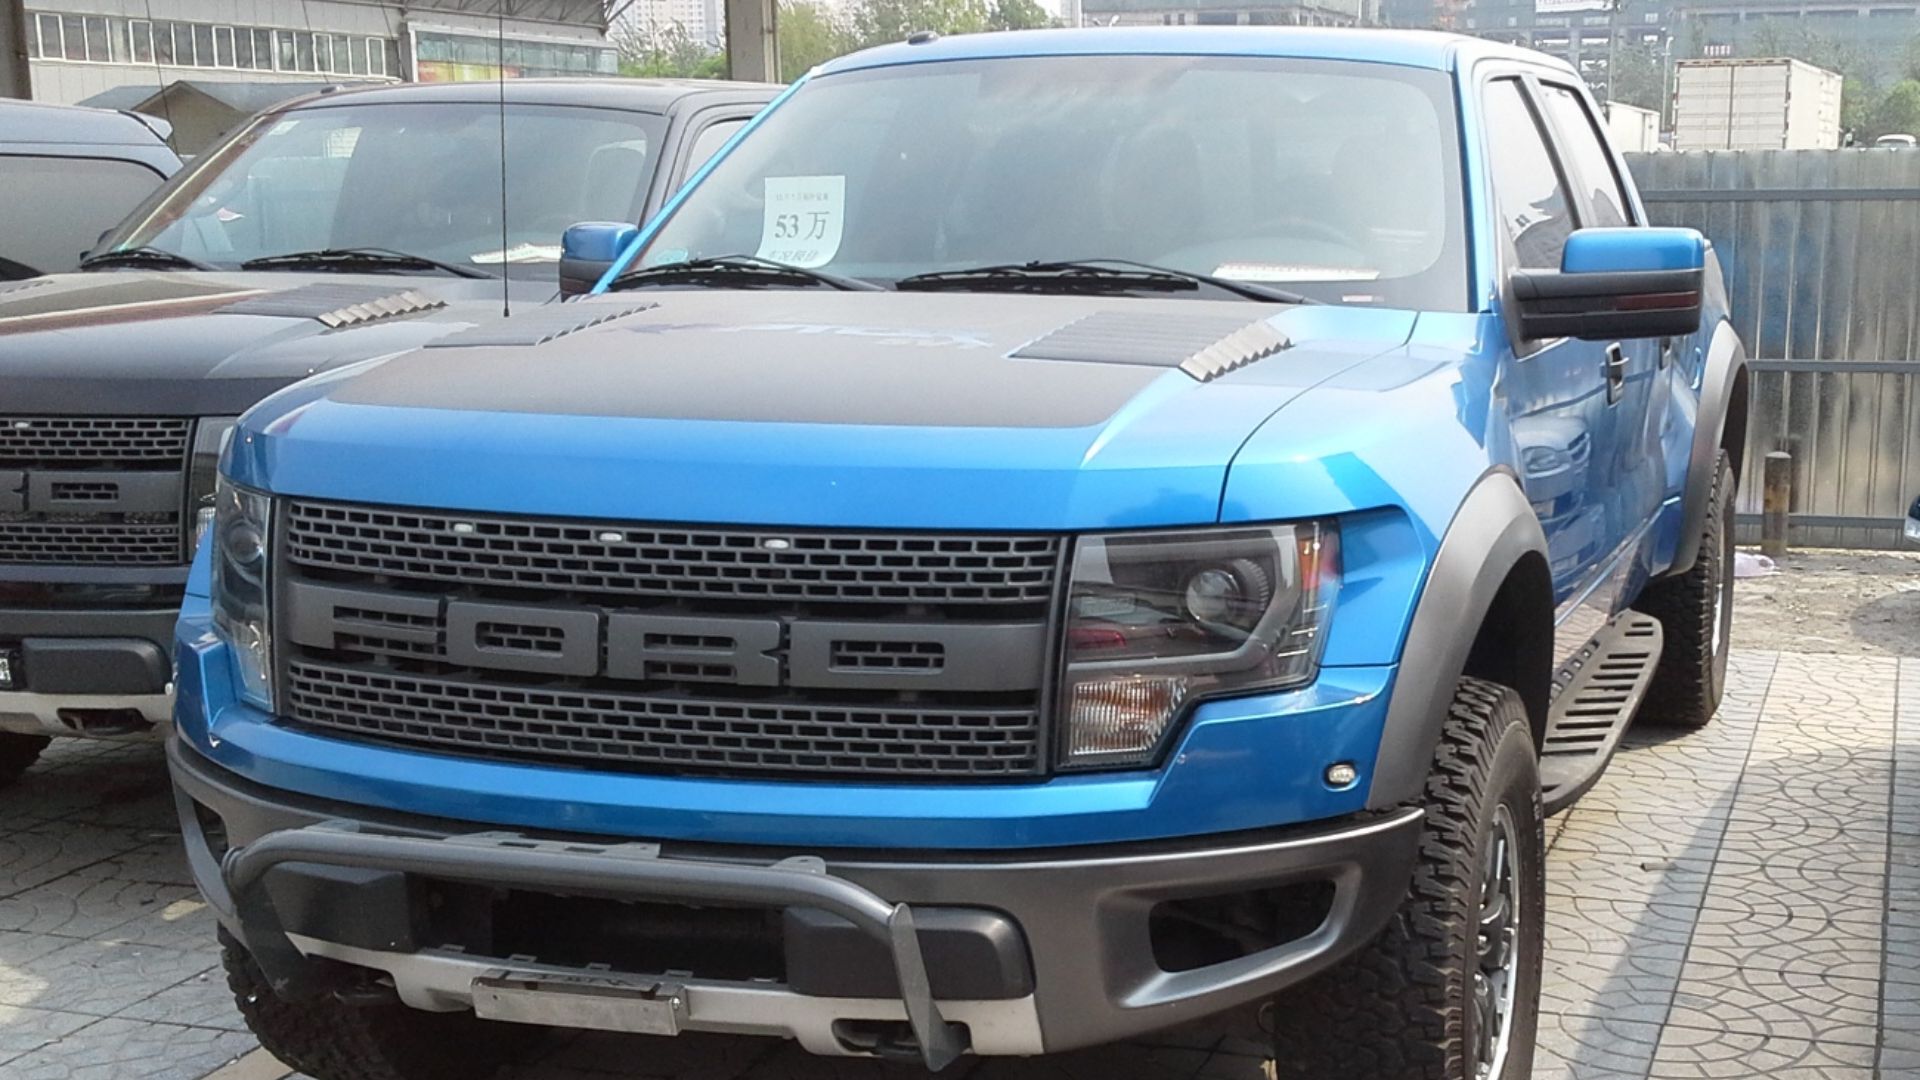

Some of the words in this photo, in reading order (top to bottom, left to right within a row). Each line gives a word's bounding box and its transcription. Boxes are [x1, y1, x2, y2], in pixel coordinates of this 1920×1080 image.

[774, 213, 799, 239] 53
[804, 210, 831, 240] 万
[286, 577, 1046, 691] FORD
